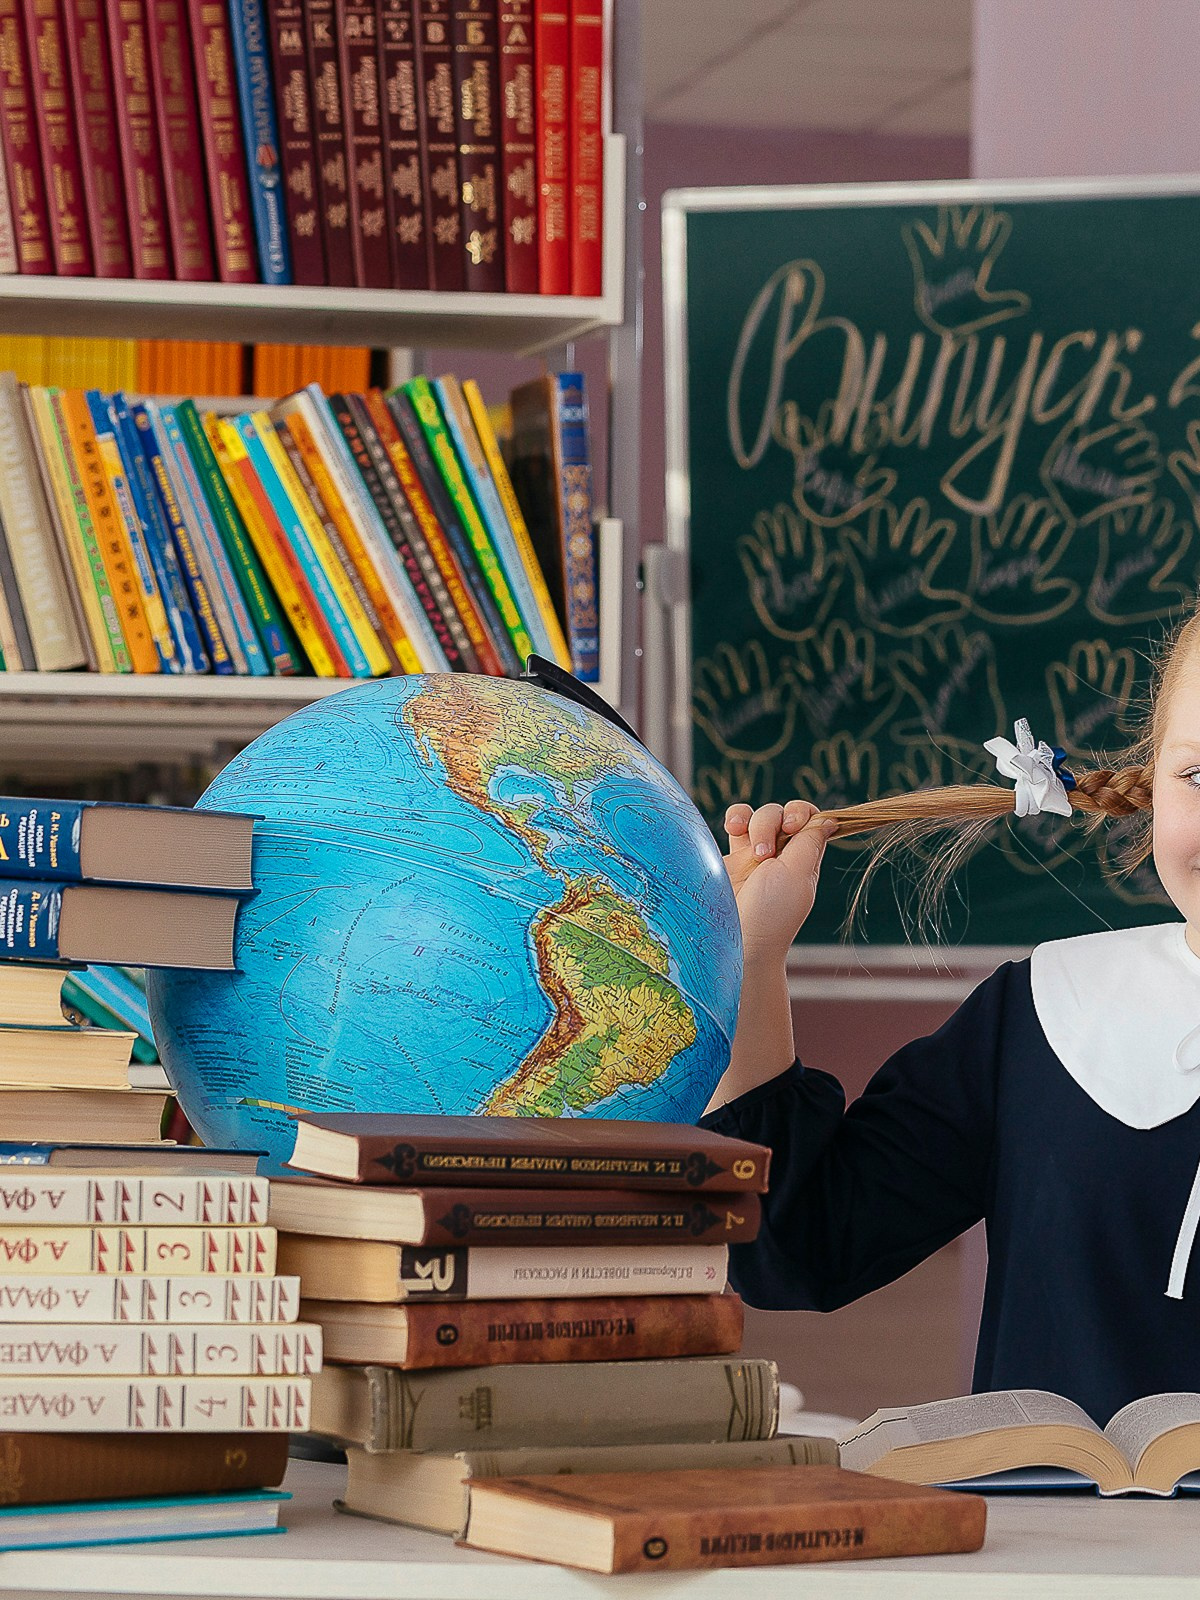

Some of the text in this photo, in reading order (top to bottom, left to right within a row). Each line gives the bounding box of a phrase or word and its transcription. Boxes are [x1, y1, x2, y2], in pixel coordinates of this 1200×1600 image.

[465, 21, 486, 45] Б
[506, 23, 528, 45] А
[17, 816, 28, 859] РЕДАКЦИЯ
[27, 808, 38, 868] СОВРЕМЕННАЯ
[35, 825, 44, 853] НОВАЯ
[49, 834, 60, 868] Ушаков
[6, 888, 18, 948] СОВРЕМЕННАЯ
[15, 904, 25, 933] НОВАЯ
[28, 914, 40, 948] Ушаков
[422, 1154, 507, 1171] ПЕЧЕРСКИЙ)
[570, 1158, 649, 1173] МЕЛЬНИКОВ
[0, 1187, 66, 1213] А. ФА
[153, 1191, 185, 1212] 2
[594, 1213, 660, 1228] МЕЛЬНИКОВ
[0, 1237, 69, 1264] А. ФА
[157, 1243, 191, 1261] 3
[512, 1267, 568, 1280] РАССКАЗЫ
[571, 1267, 580, 1280] И
[581, 1266, 631, 1280] ПОВЕСТИ
[0, 1286, 90, 1312] А. ФАД
[179, 1291, 213, 1308] 3
[94, 1342, 118, 1364] А.
[205, 1345, 239, 1364] 3
[81, 1395, 106, 1416] А.
[193, 1396, 228, 1419] 4
